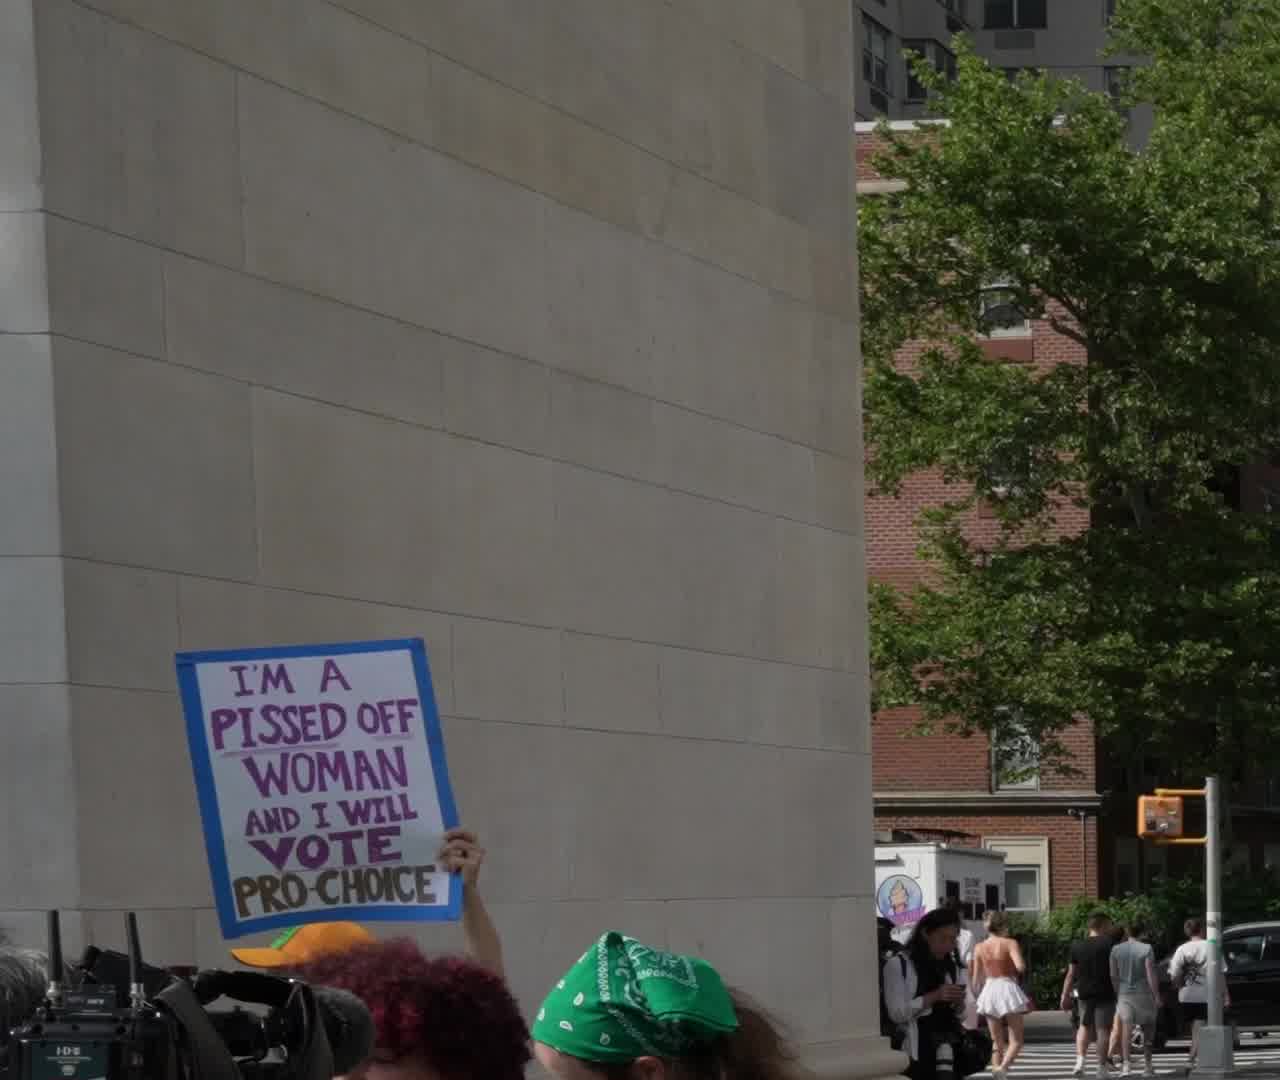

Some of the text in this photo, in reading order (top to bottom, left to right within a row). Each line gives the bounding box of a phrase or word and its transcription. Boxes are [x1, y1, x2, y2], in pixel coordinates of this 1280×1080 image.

[229, 659, 352, 697] I'M A
[211, 698, 418, 750] PISSED OFF
[243, 745, 409, 798] WOMAN
[245, 793, 418, 836] AND I WILL
[249, 826, 402, 871] VOTE
[233, 865, 437, 918] PRO-CHOICE
